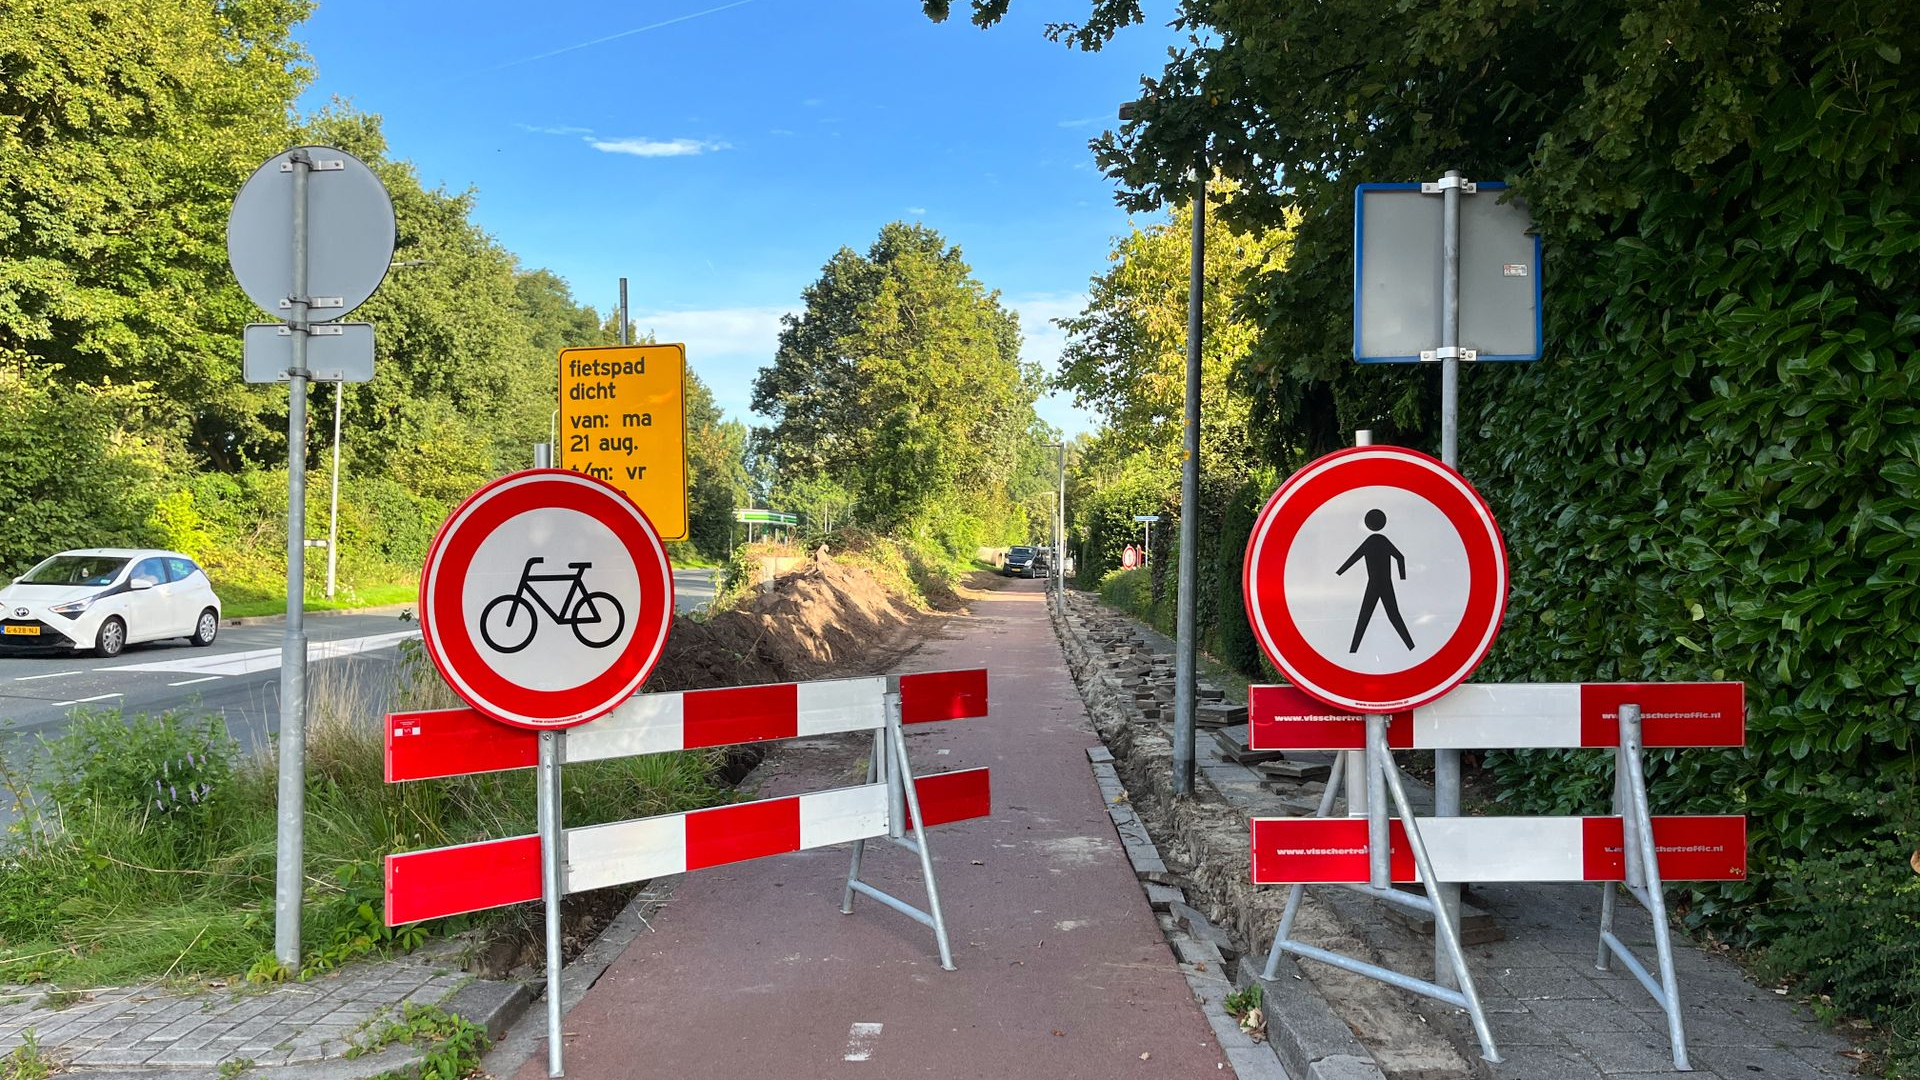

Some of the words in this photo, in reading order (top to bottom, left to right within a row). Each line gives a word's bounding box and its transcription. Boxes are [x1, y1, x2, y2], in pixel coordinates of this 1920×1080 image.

[569, 356, 645, 379] fietspad
[569, 382, 616, 400] dicht
[570, 414, 609, 429] van:
[623, 413, 652, 427] ma
[570, 434, 589, 452] 21
[599, 437, 639, 456] aug.
[626, 466, 647, 480] vr
[1602, 711, 1721, 719] wwsschertraffic.nl
